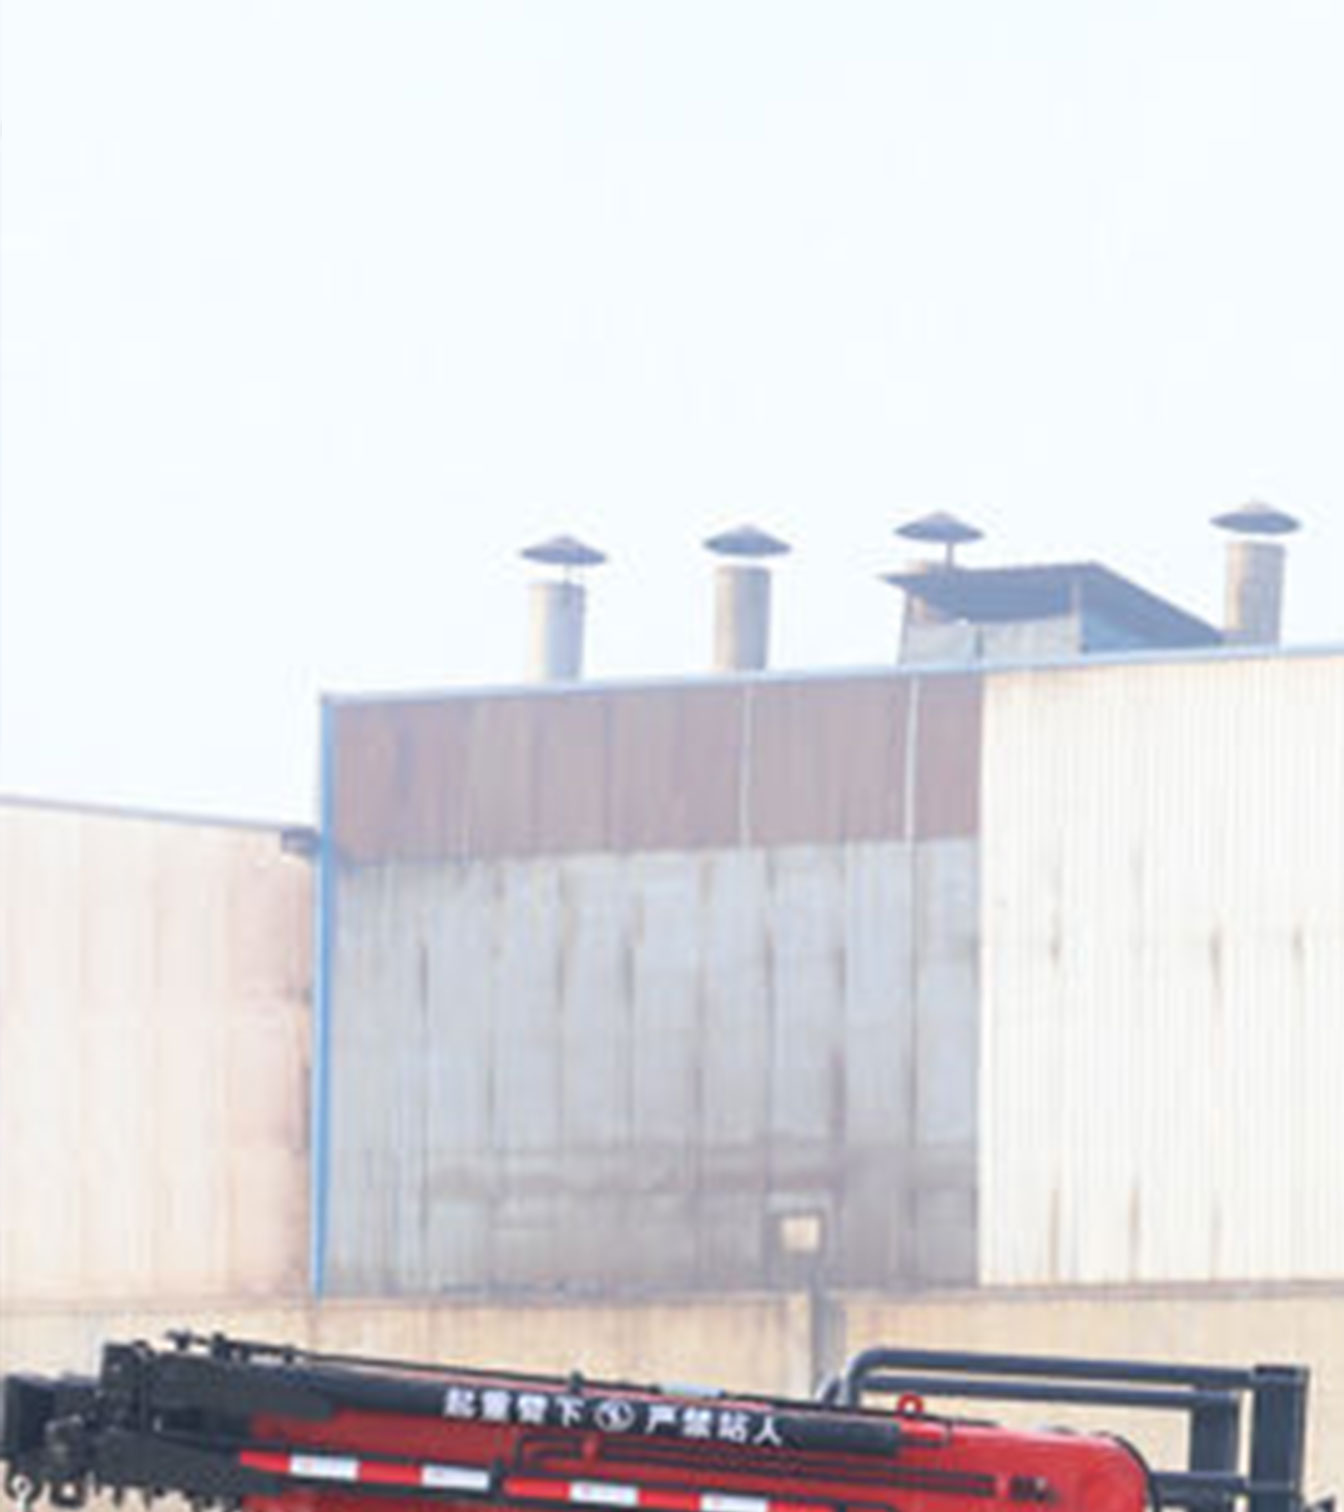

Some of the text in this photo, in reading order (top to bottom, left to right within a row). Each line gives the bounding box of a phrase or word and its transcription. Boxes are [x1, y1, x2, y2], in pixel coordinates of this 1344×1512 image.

[444, 1386, 783, 1446] 起重臂下 严禁站人
